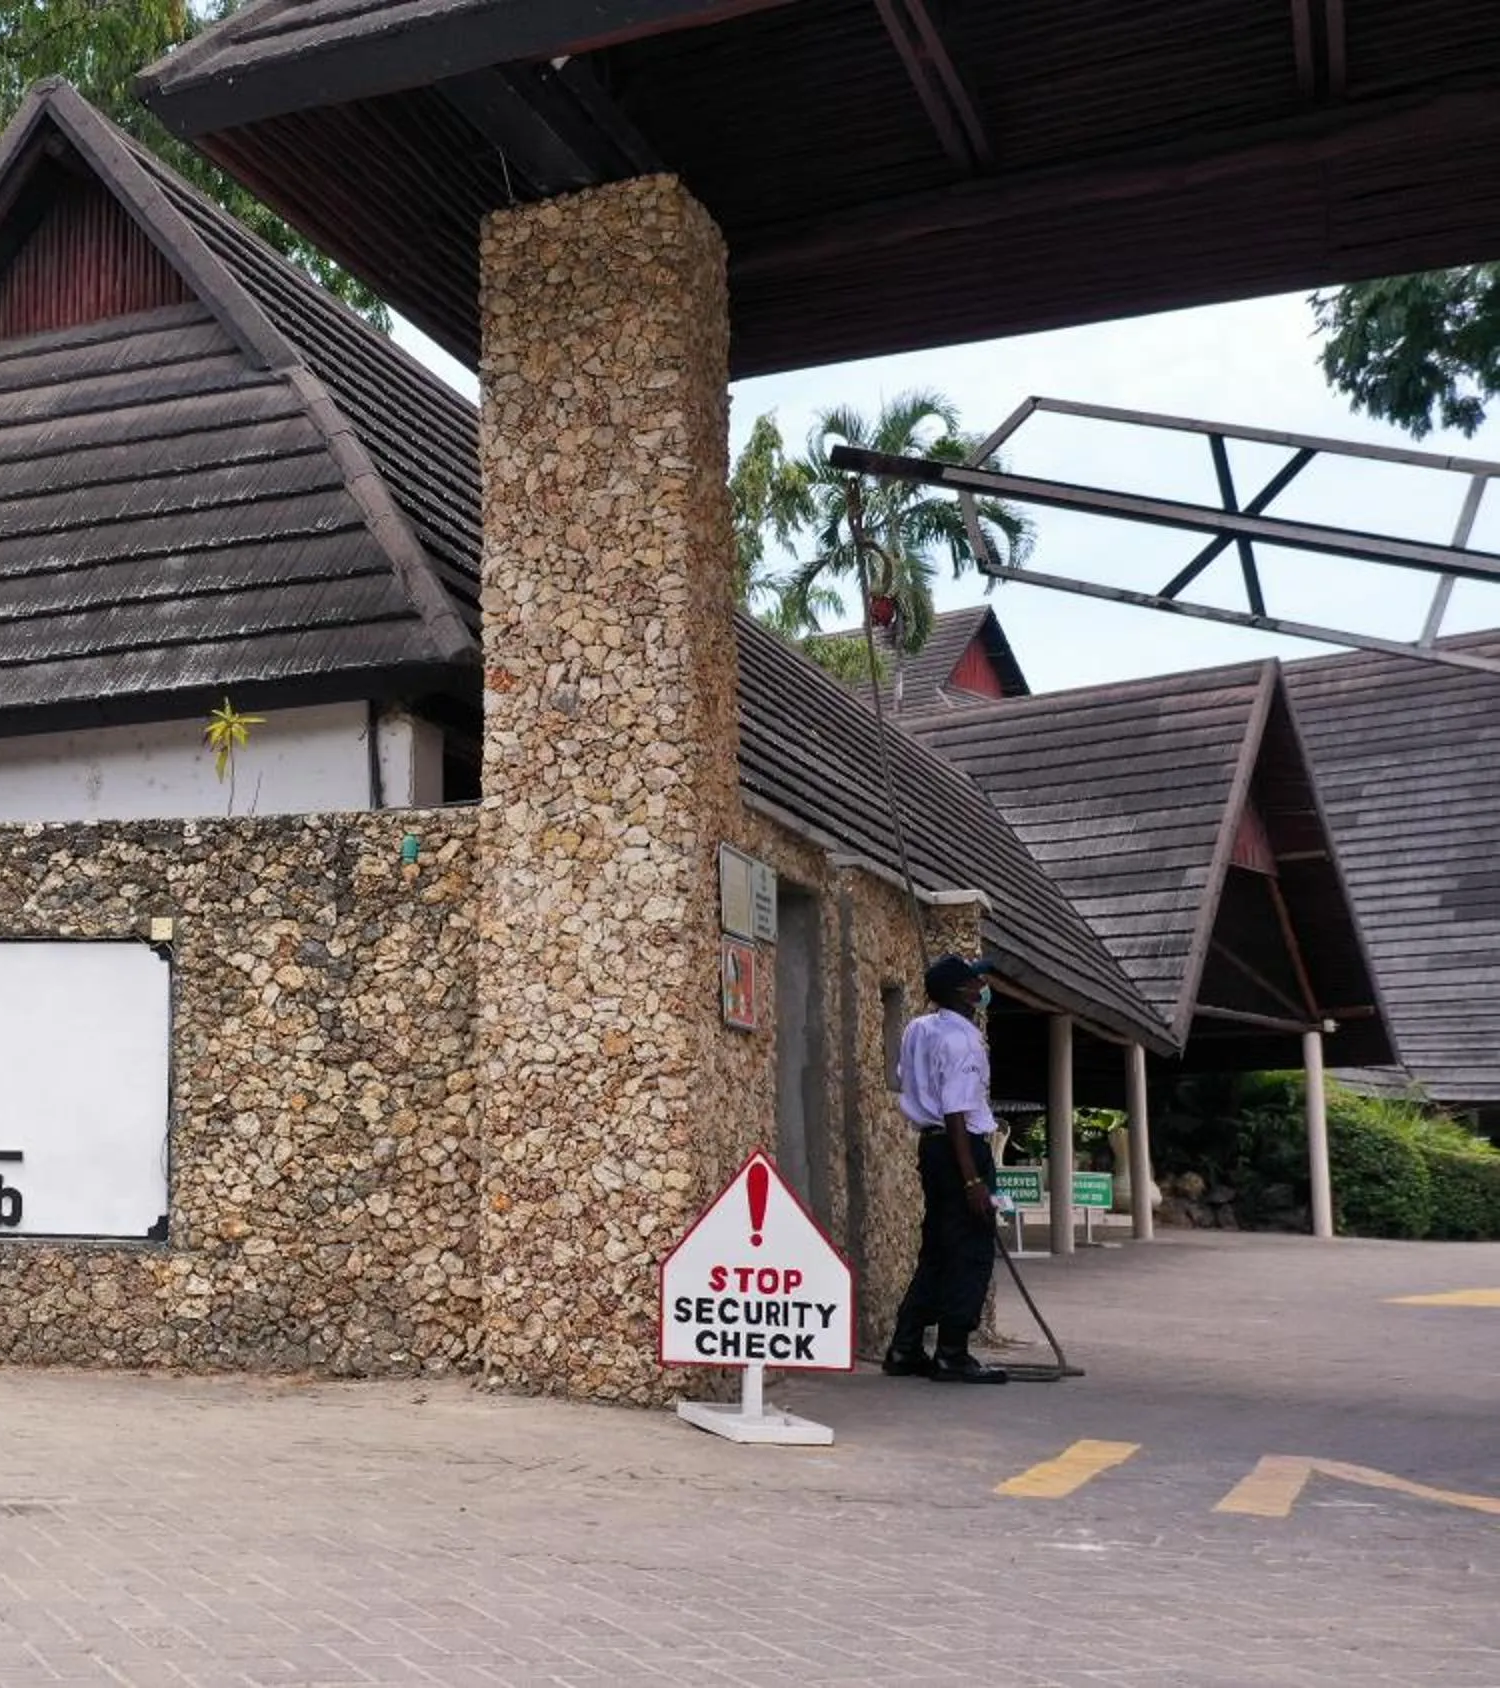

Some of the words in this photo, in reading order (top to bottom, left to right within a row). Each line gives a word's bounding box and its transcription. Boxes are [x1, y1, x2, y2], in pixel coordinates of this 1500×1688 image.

[996, 1176, 1037, 1187] ESERVED
[708, 1265, 803, 1295] STOP
[673, 1296, 837, 1329] SECURITY
[694, 1330, 815, 1361] CHECK
